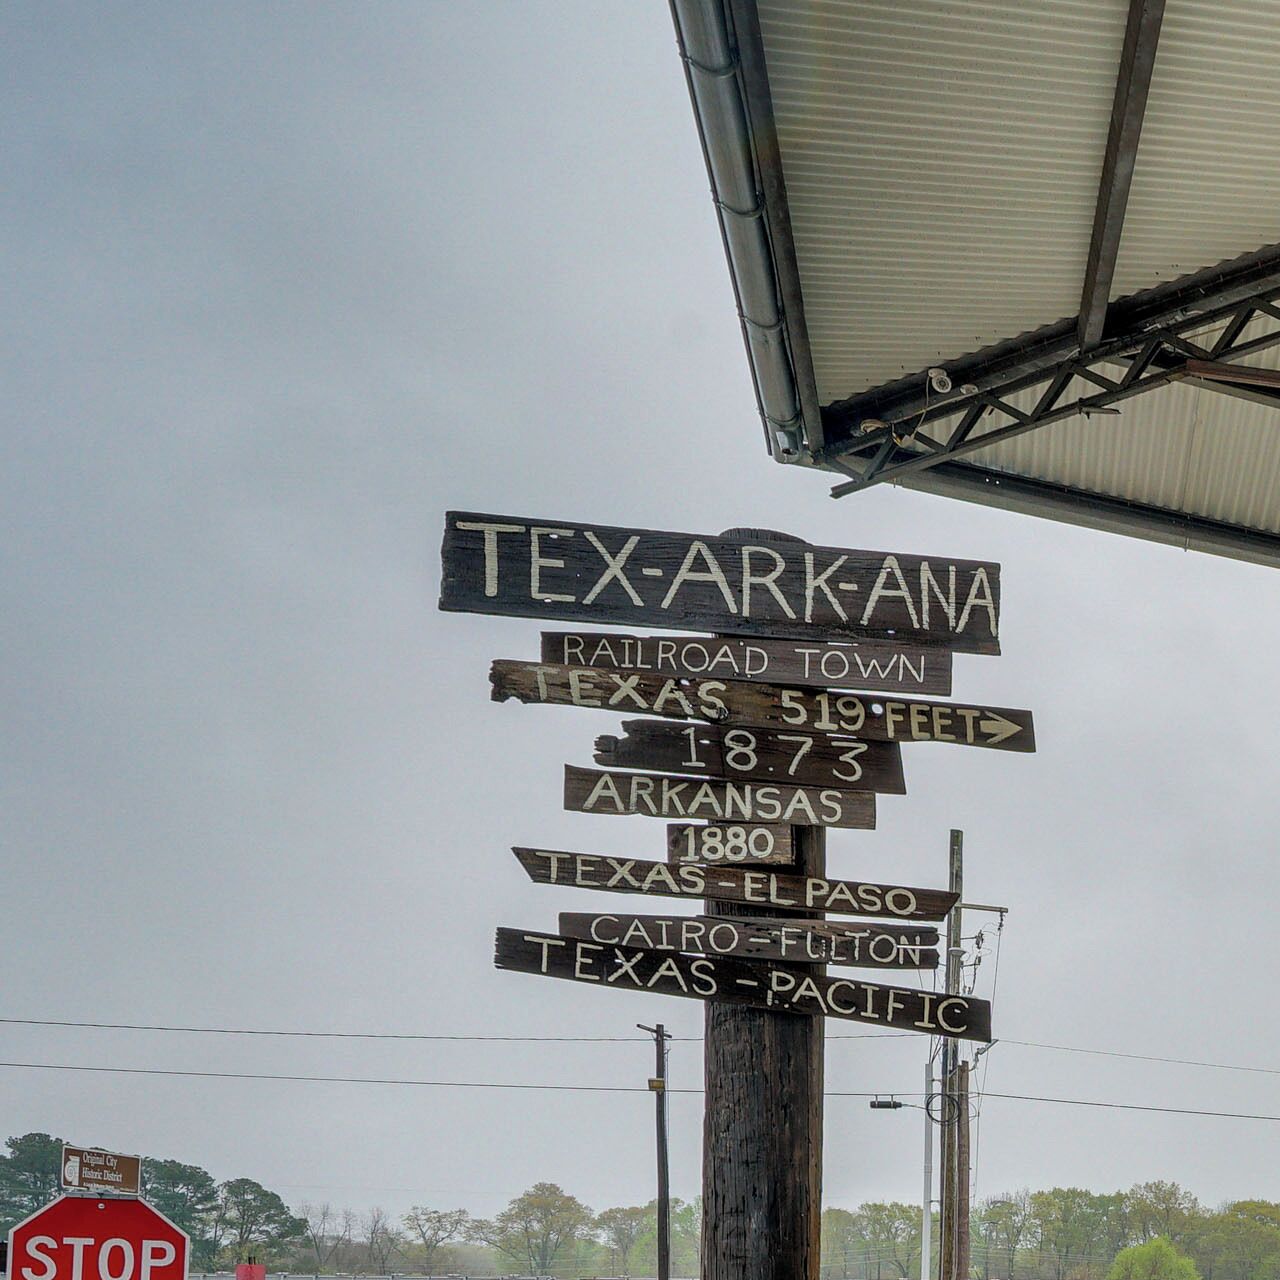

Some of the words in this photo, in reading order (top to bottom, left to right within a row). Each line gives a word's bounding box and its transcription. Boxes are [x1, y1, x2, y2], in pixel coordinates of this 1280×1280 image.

[455, 521, 999, 637] TEX-ARK-ANA
[563, 635, 769, 676] RAILROAD
[802, 649, 926, 683] TOWN
[528, 664, 728, 719] TEXAS
[781, 690, 865, 732] 519
[886, 703, 981, 743] FEET
[681, 727, 869, 782] 1873
[582, 773, 844, 825] ARKANSAS
[682, 826, 774, 863] 1880
[806, 878, 917, 916] PASO
